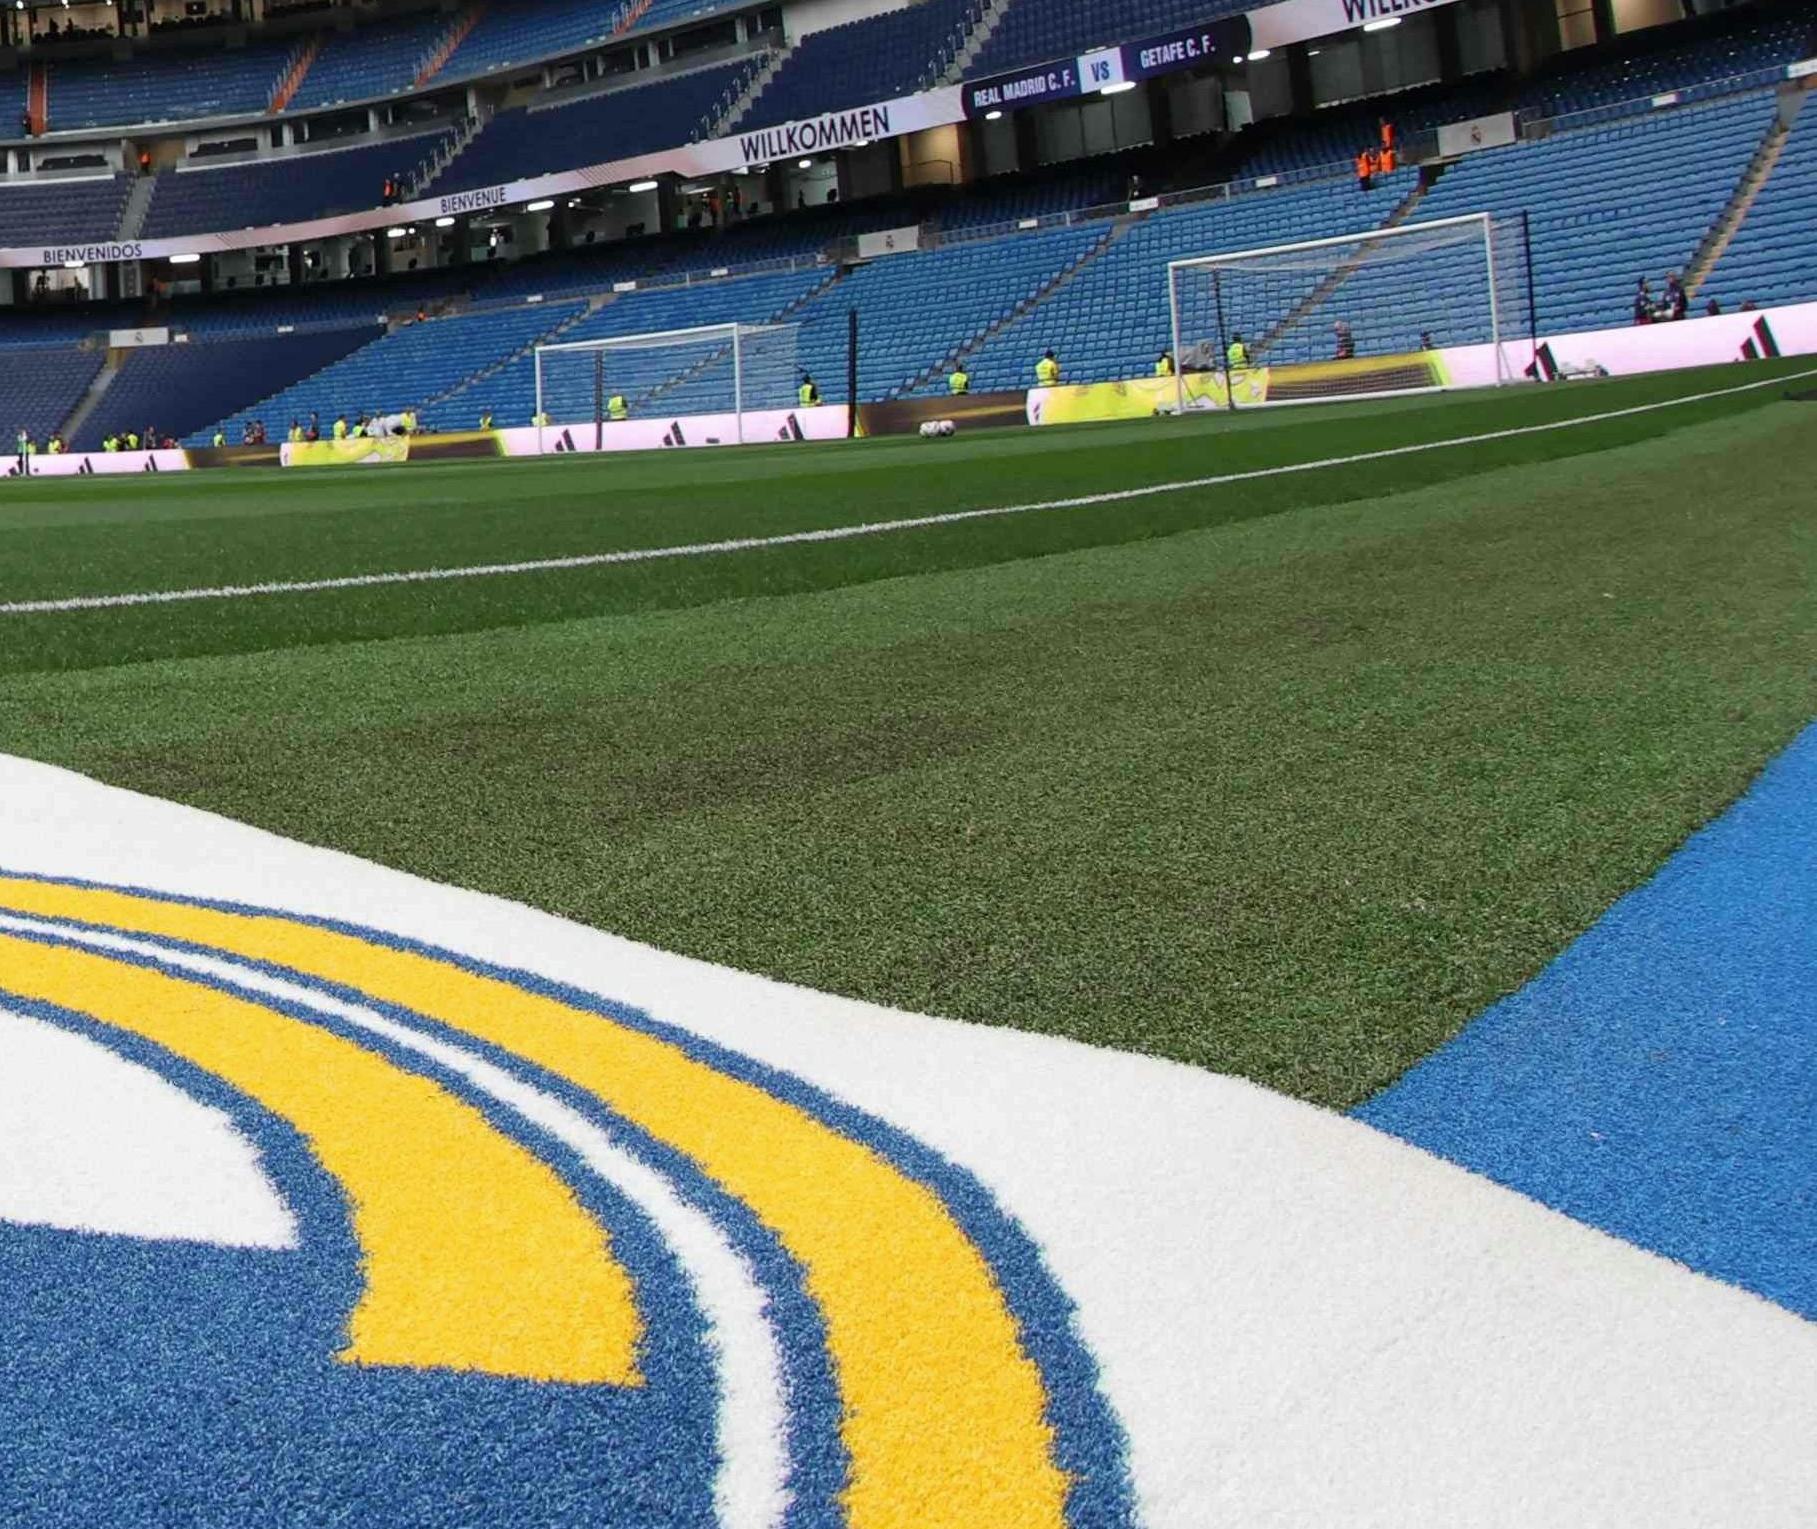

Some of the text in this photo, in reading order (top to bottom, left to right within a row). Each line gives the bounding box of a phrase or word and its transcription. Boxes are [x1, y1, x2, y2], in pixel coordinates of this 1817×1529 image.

[1140, 35, 1215, 69] GETAFE C. F.
[1091, 61, 1110, 82] VS
[974, 70, 1075, 107] REAL MADRID C. F.
[740, 106, 890, 163] WILLKOMMEN
[441, 187, 506, 213] BIENVENUE
[44, 243, 142, 264] BIENVENIDOS
